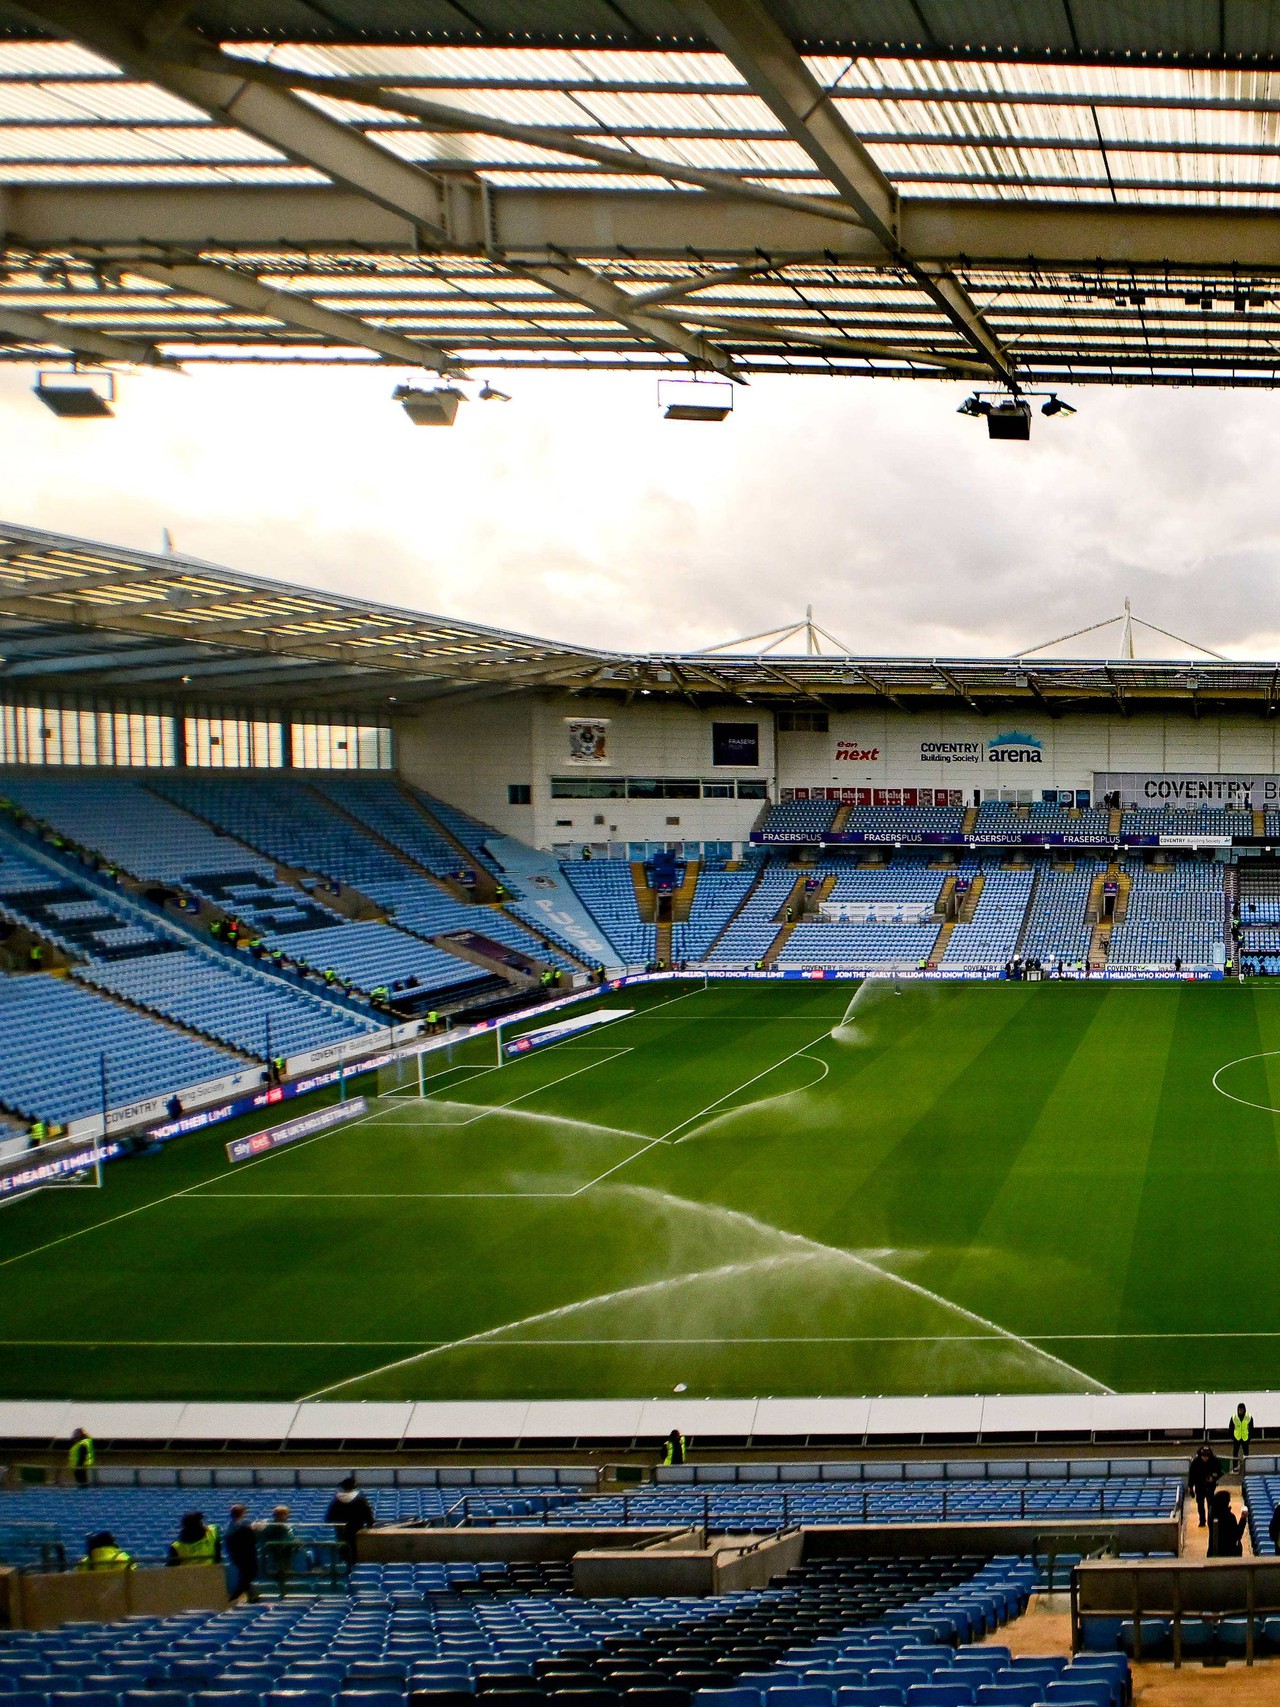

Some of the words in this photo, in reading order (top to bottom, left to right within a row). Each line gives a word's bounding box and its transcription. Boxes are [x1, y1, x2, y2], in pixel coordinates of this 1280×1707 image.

[920, 742, 979, 753] COVENTRY
[835, 748, 880, 762] next
[920, 754, 951, 764] Building
[952, 754, 979, 764] Society
[988, 748, 1042, 762] arena
[833, 790, 865, 799] Mahou
[878, 790, 911, 800] Mahou
[1144, 780, 1254, 799] COVENTRY
[762, 833, 822, 841] FRASERSPLUS
[864, 834, 922, 842] FRASERSPLUS
[964, 834, 1022, 842] FRASERSPLUS
[1064, 835, 1120, 843] FRASERSPLUS
[254, 1094, 268, 1106] sky
[106, 1100, 158, 1124] COVENTRY
[208, 1106, 233, 1123] LIMIT
[234, 1144, 250, 1156] sky
[272, 1129, 288, 1141] THE
